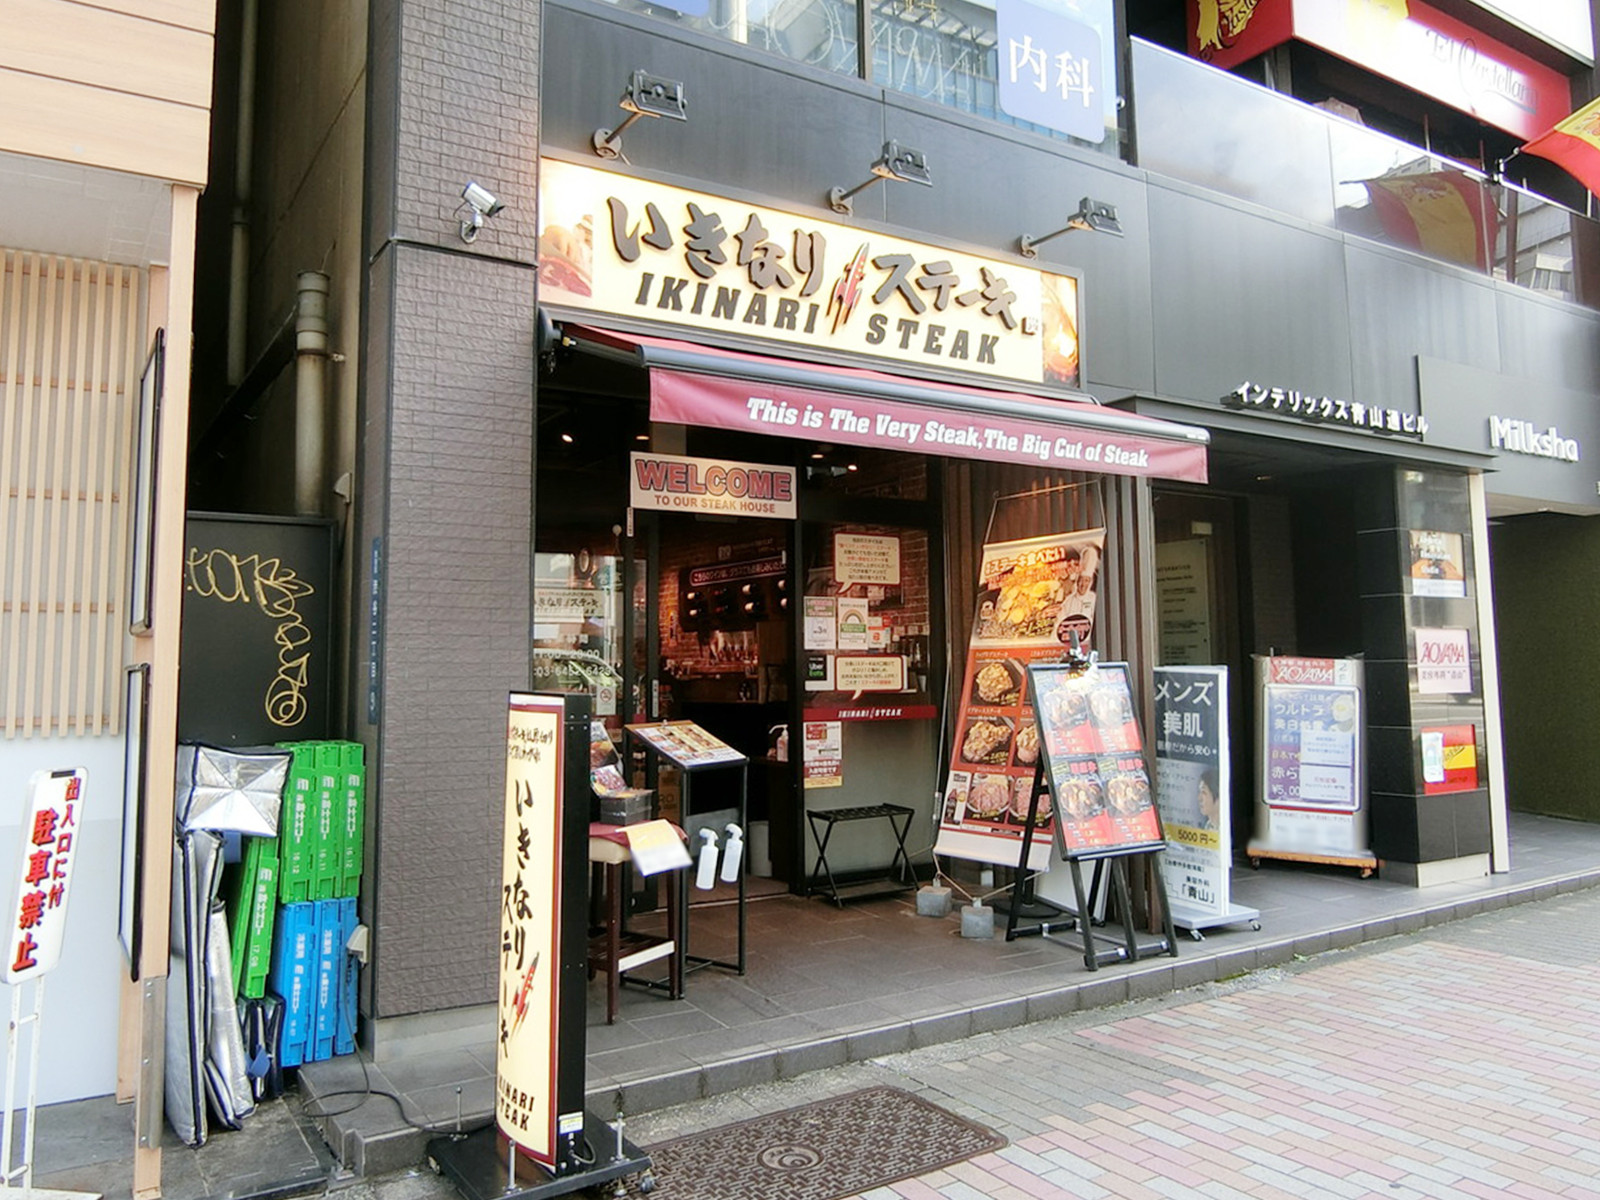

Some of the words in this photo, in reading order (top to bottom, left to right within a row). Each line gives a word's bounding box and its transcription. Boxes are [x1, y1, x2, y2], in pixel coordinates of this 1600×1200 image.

[1009, 35, 1095, 108] 内科
[606, 196, 827, 298] いきなり
[871, 253, 1017, 331] ステーキ
[634, 272, 821, 334] IKINARI
[865, 313, 999, 365] STEAK
[747, 397, 798, 425] This
[802, 404, 823, 428] is
[829, 408, 869, 434] The
[875, 413, 922, 444] Very
[1022, 433, 1051, 461] Big
[1054, 437, 1083, 459] Cut
[1085, 442, 1104, 462] of
[1104, 444, 1149, 468] Steak
[1489, 414, 1580, 463] Milksha
[635, 459, 792, 502] WELCOME
[654, 494, 670, 506] TO
[673, 496, 699, 508] OUR
[700, 498, 737, 511] STEAK
[740, 501, 776, 514] HOUSE
[1420, 642, 1465, 664] AOYAMA
[875, 708, 902, 717] STEAK
[1154, 680, 1215, 706] メンズ
[1274, 702, 1326, 717] ウルトラ
[1162, 710, 1204, 738] 美肌
[48, 777, 82, 909] 出入口に付
[12, 807, 60, 973] 駐車禁止
[513, 779, 534, 971] いきなり
[500, 885, 514, 1059] ステーキ
